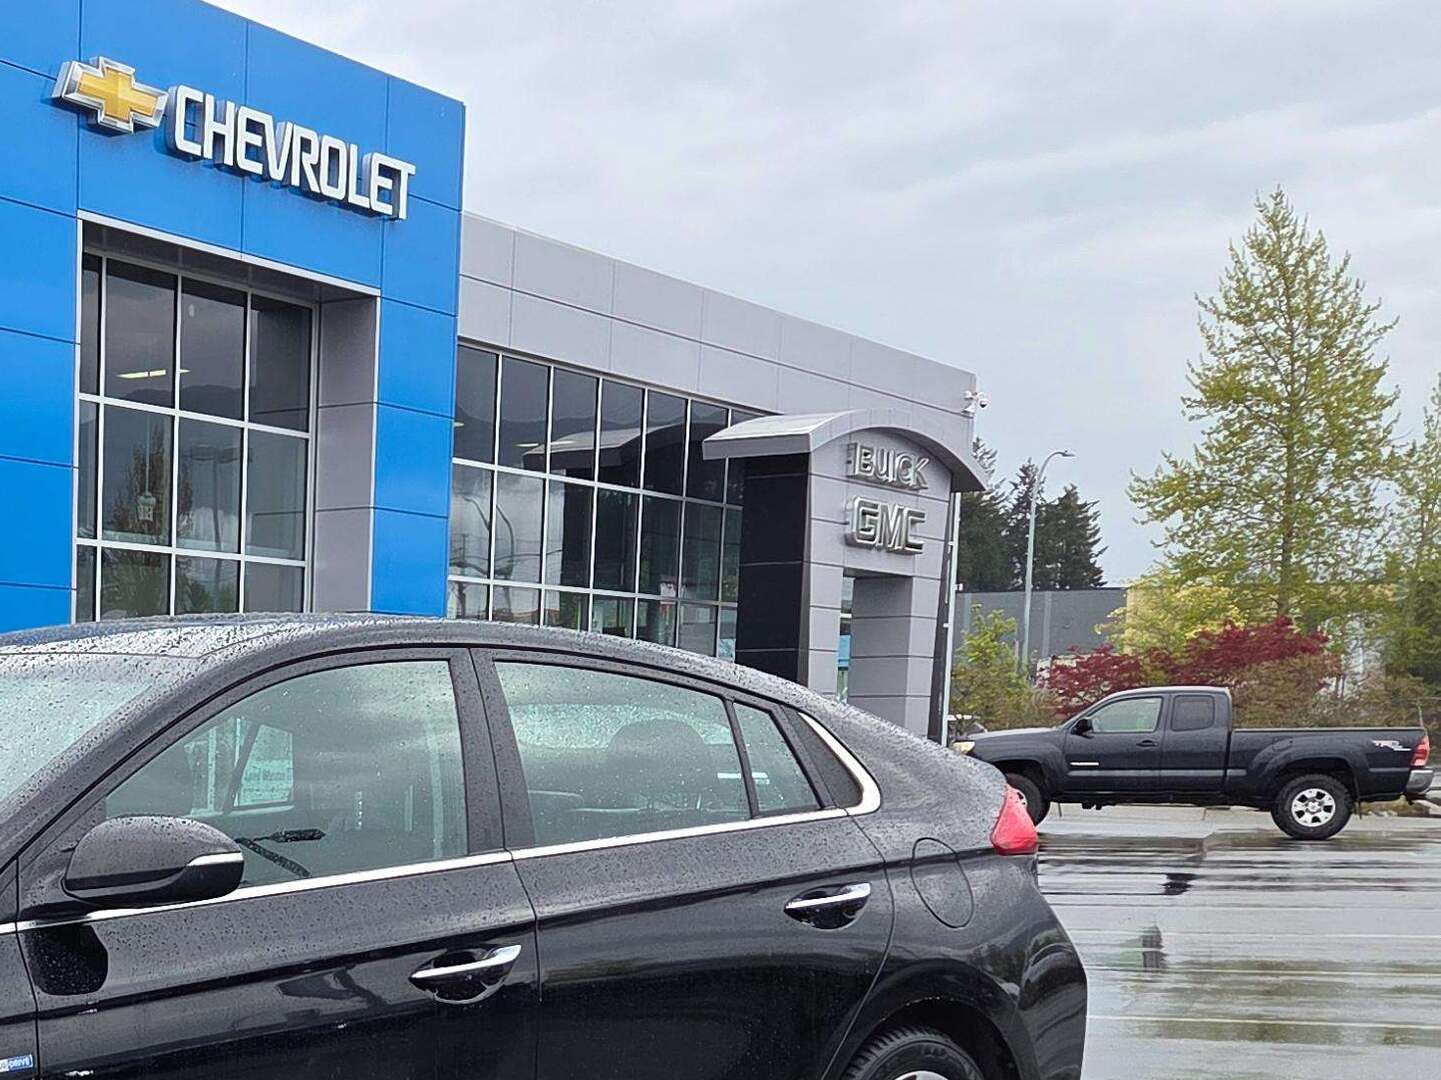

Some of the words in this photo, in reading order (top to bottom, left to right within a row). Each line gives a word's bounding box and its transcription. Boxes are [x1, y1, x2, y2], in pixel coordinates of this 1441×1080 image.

[168, 84, 416, 220] CHEVROLET
[848, 443, 930, 490] BUICK
[849, 496, 927, 553] GMC
